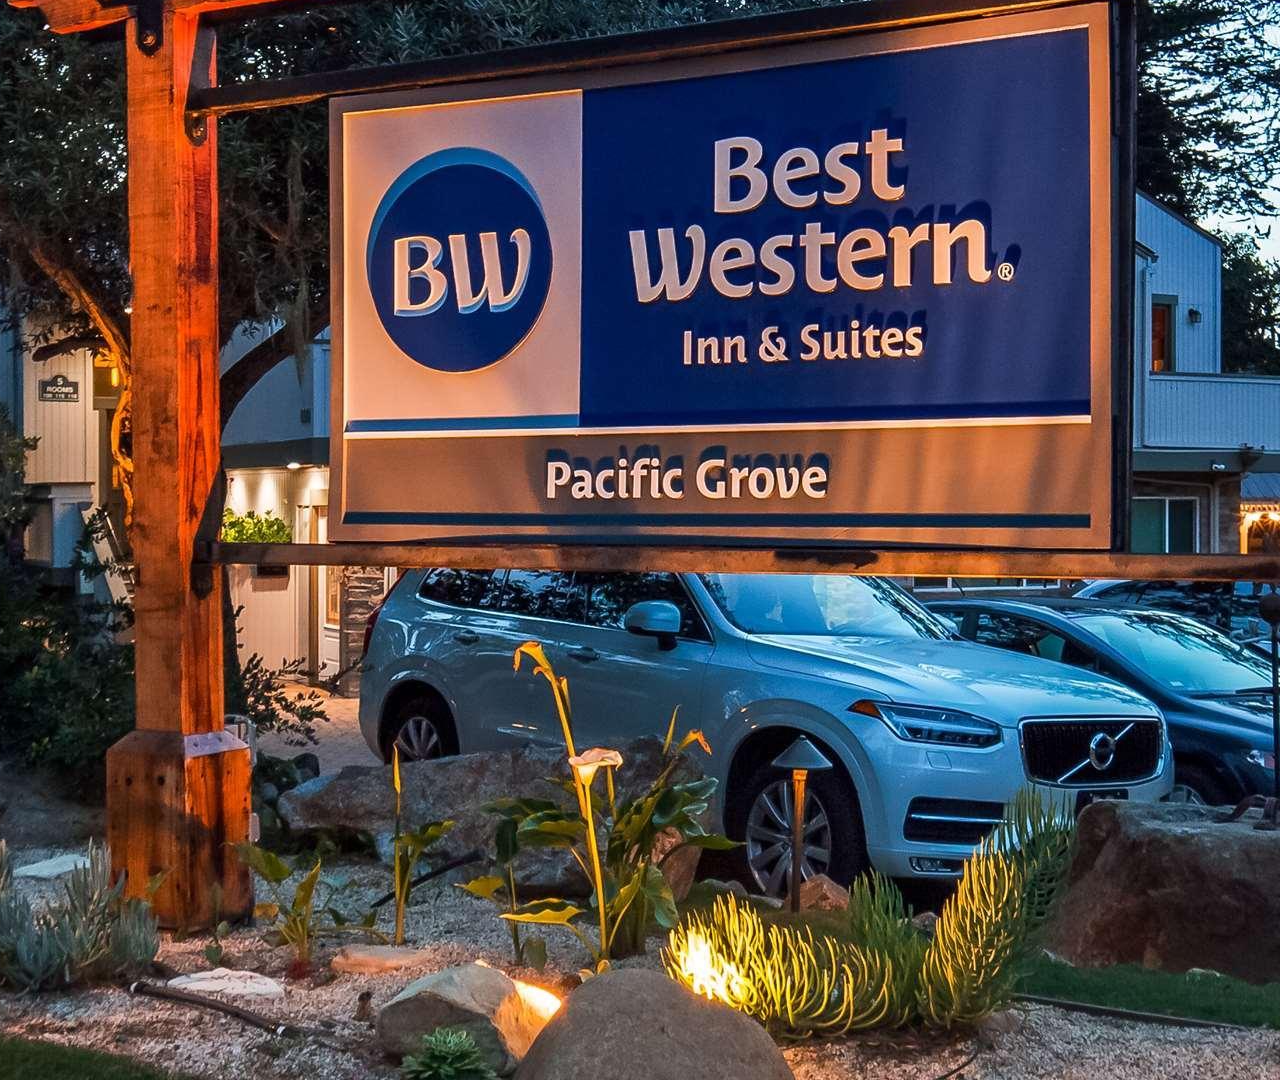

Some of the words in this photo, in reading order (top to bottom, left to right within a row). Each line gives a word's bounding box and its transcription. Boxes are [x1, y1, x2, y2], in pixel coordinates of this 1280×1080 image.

[714, 128, 905, 213] Best
[394, 228, 531, 317] BW
[683, 329, 747, 365] Inn
[758, 325, 789, 362] &
[800, 320, 923, 361] Suites
[546, 457, 683, 499] Pacific
[696, 458, 827, 499] Grove
